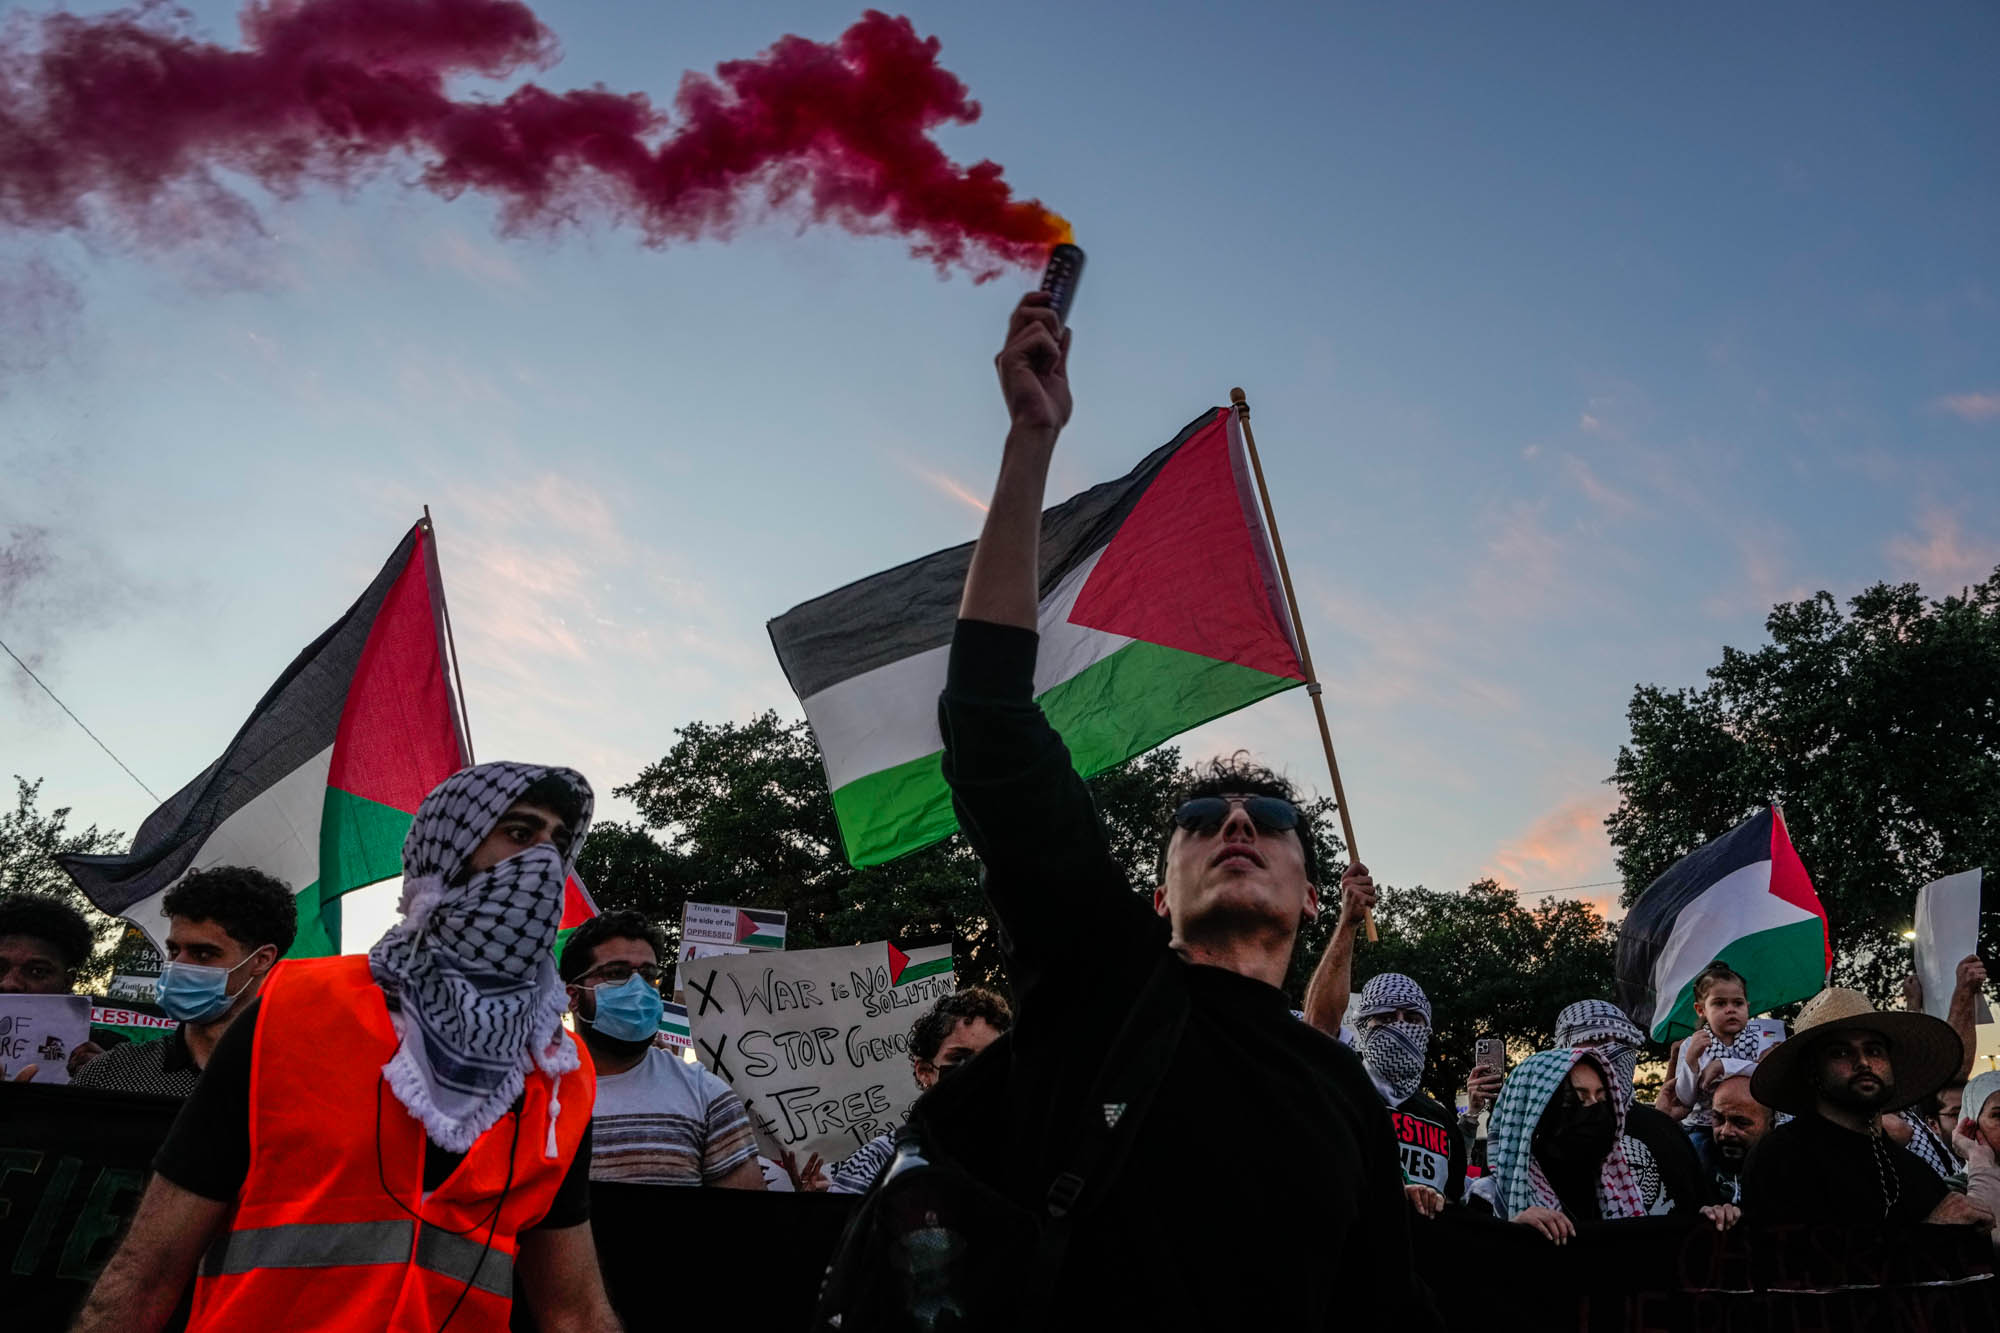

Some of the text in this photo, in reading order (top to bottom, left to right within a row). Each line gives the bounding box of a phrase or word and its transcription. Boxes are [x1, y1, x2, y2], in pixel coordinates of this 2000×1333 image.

[694, 904, 712, 913] Truth
[686, 916, 698, 924] the
[686, 928, 733, 940] OPPRESSED
[727, 967, 823, 1017] WAR
[851, 964, 889, 997] NO
[737, 1026, 840, 1078] STOP
